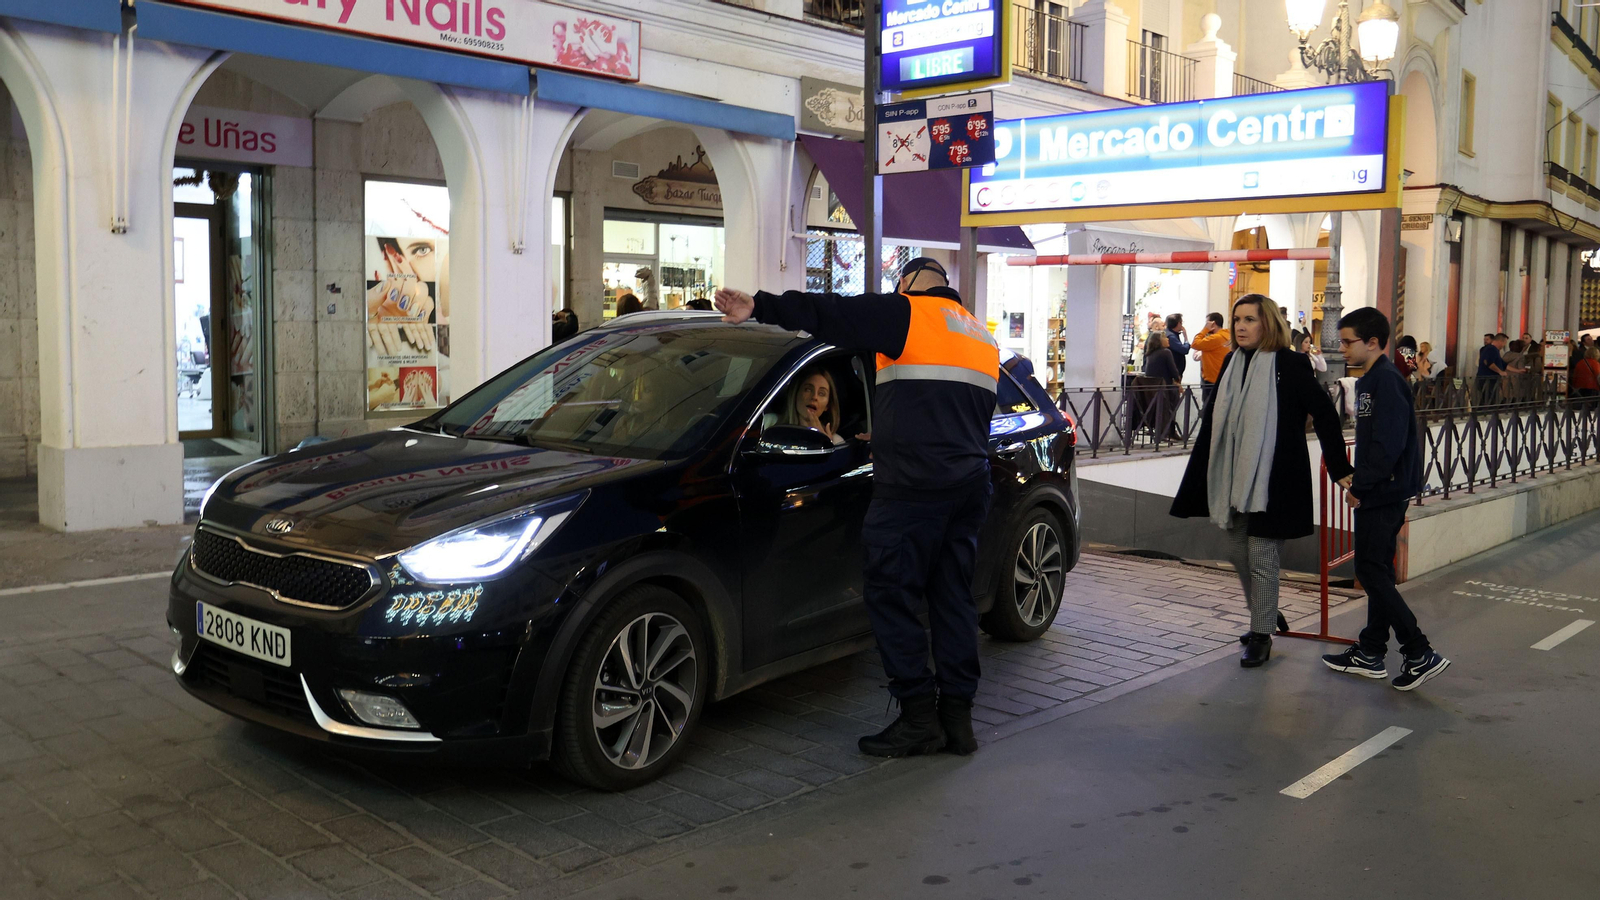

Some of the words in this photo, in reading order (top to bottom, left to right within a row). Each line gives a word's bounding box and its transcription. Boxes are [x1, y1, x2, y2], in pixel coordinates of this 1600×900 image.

[886, 4, 941, 27] Mercado
[912, 53, 964, 80] LIBRE
[885, 110, 897, 118] SIN
[898, 109, 919, 117] P-app
[938, 104, 951, 112] CON
[203, 117, 277, 154] Uñas
[1039, 115, 1194, 161] Mercado
[663, 183, 695, 201] Bazar
[206, 611, 245, 647] 2808
[250, 624, 286, 660] KND
